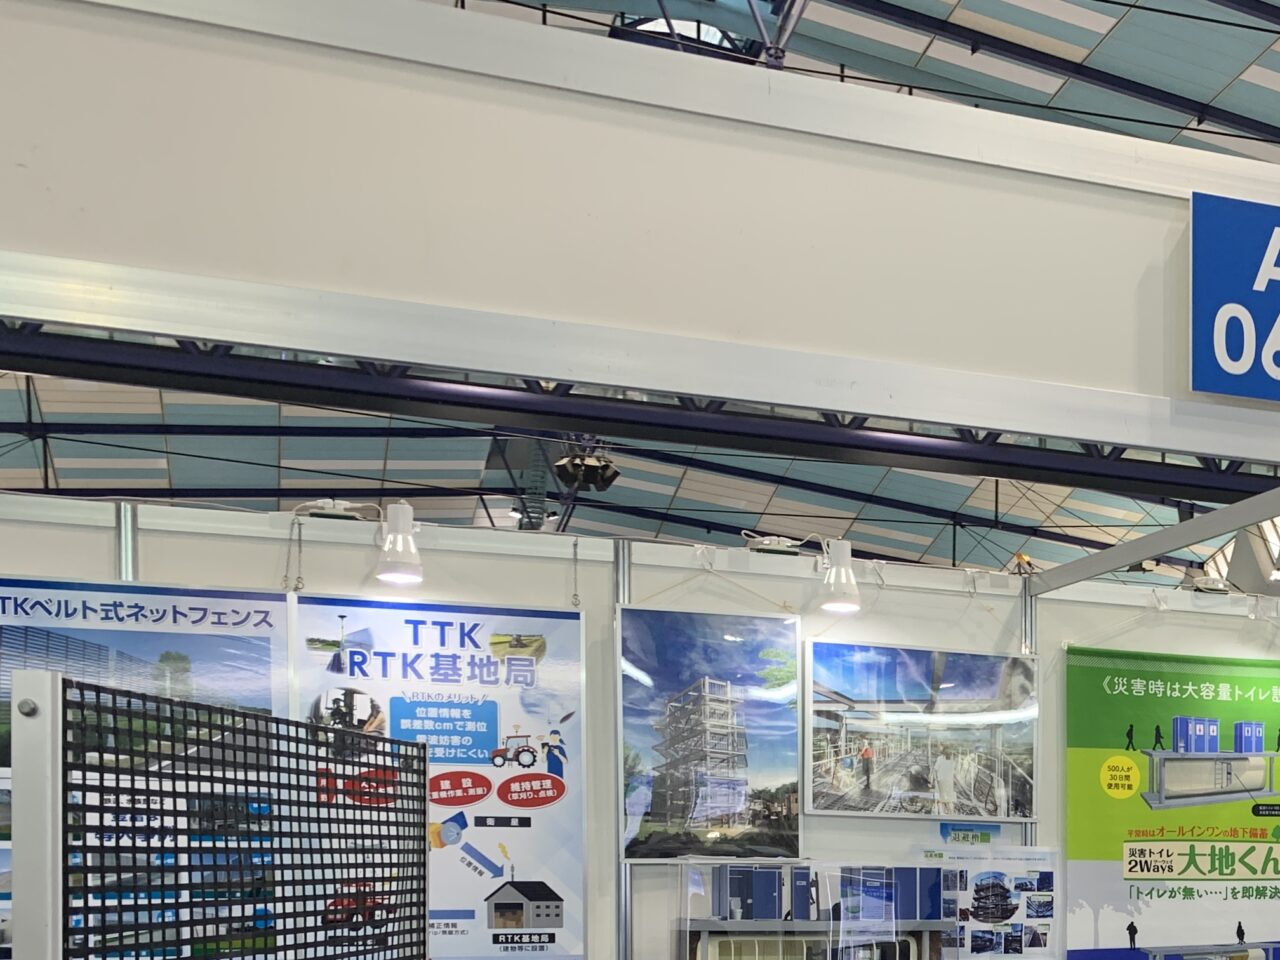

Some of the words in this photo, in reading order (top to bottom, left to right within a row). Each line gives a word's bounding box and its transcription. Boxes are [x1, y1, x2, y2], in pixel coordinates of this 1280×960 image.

[403, 619, 482, 650] TTK
[347, 650, 536, 688] RTK基地局
